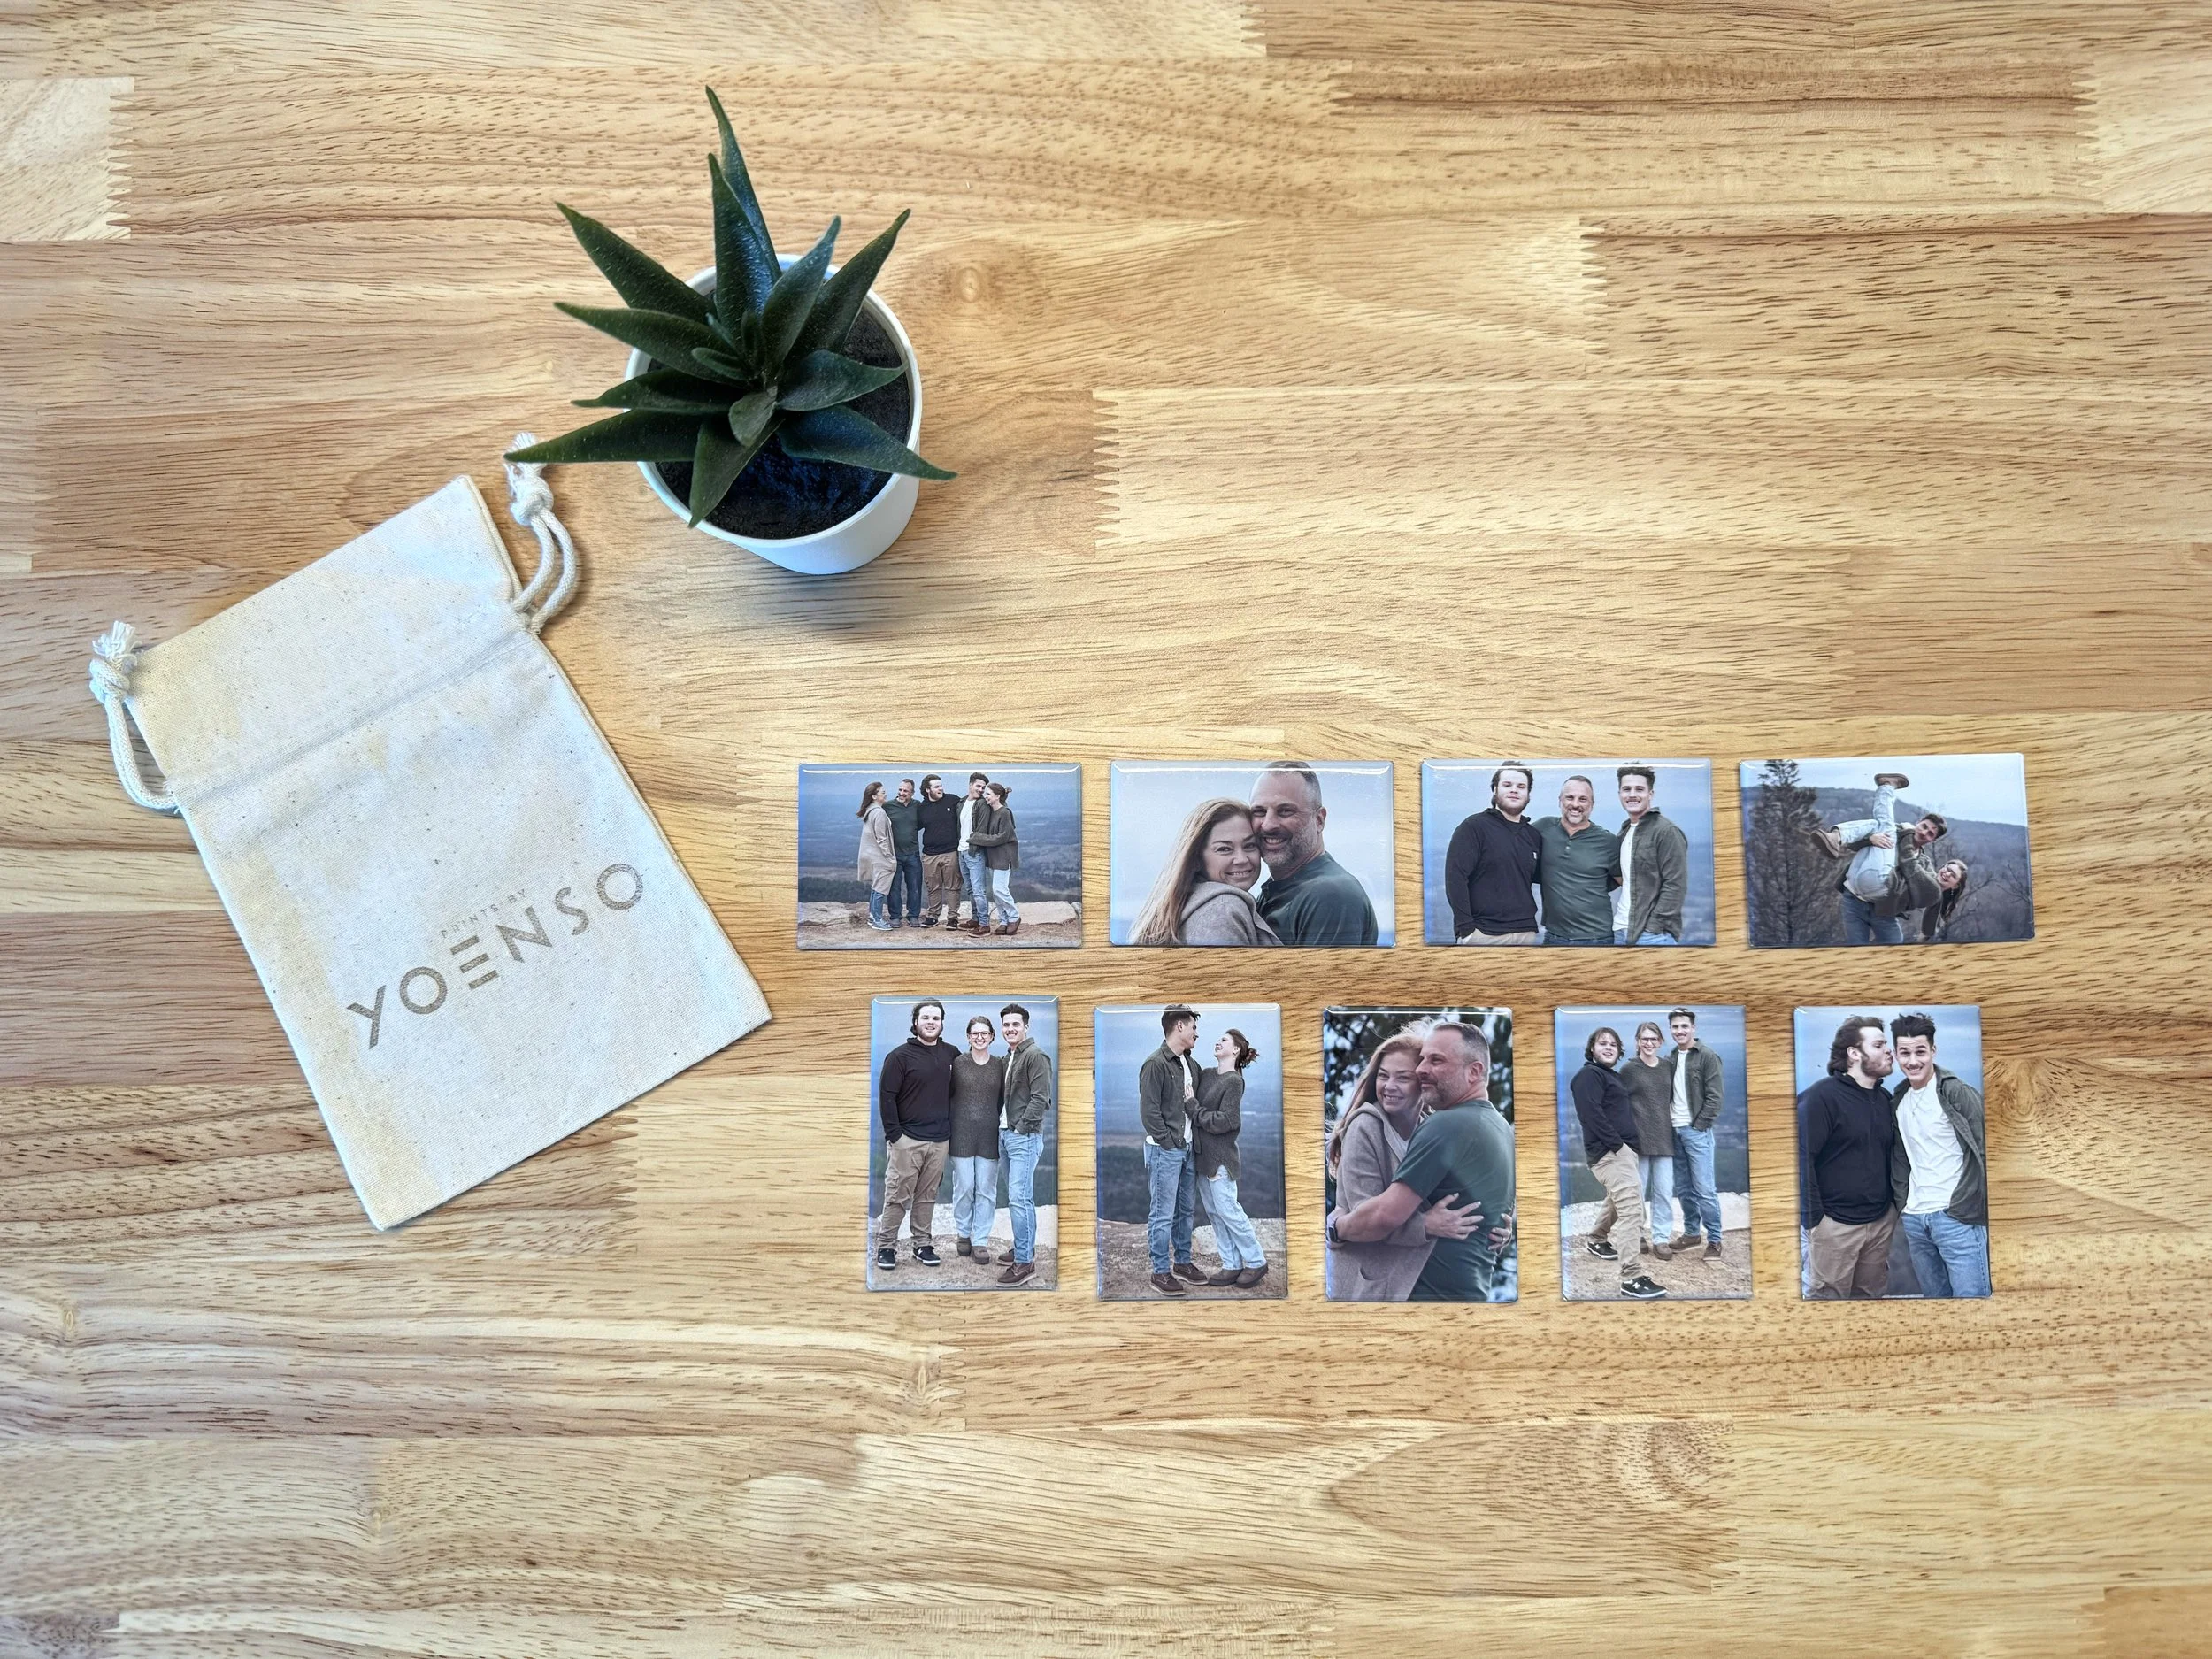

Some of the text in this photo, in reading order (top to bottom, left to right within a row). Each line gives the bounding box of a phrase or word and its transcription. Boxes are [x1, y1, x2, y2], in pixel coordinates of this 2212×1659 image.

[347, 863, 644, 1050] YOENSO
[440, 888, 526, 939] PRINTS BY
